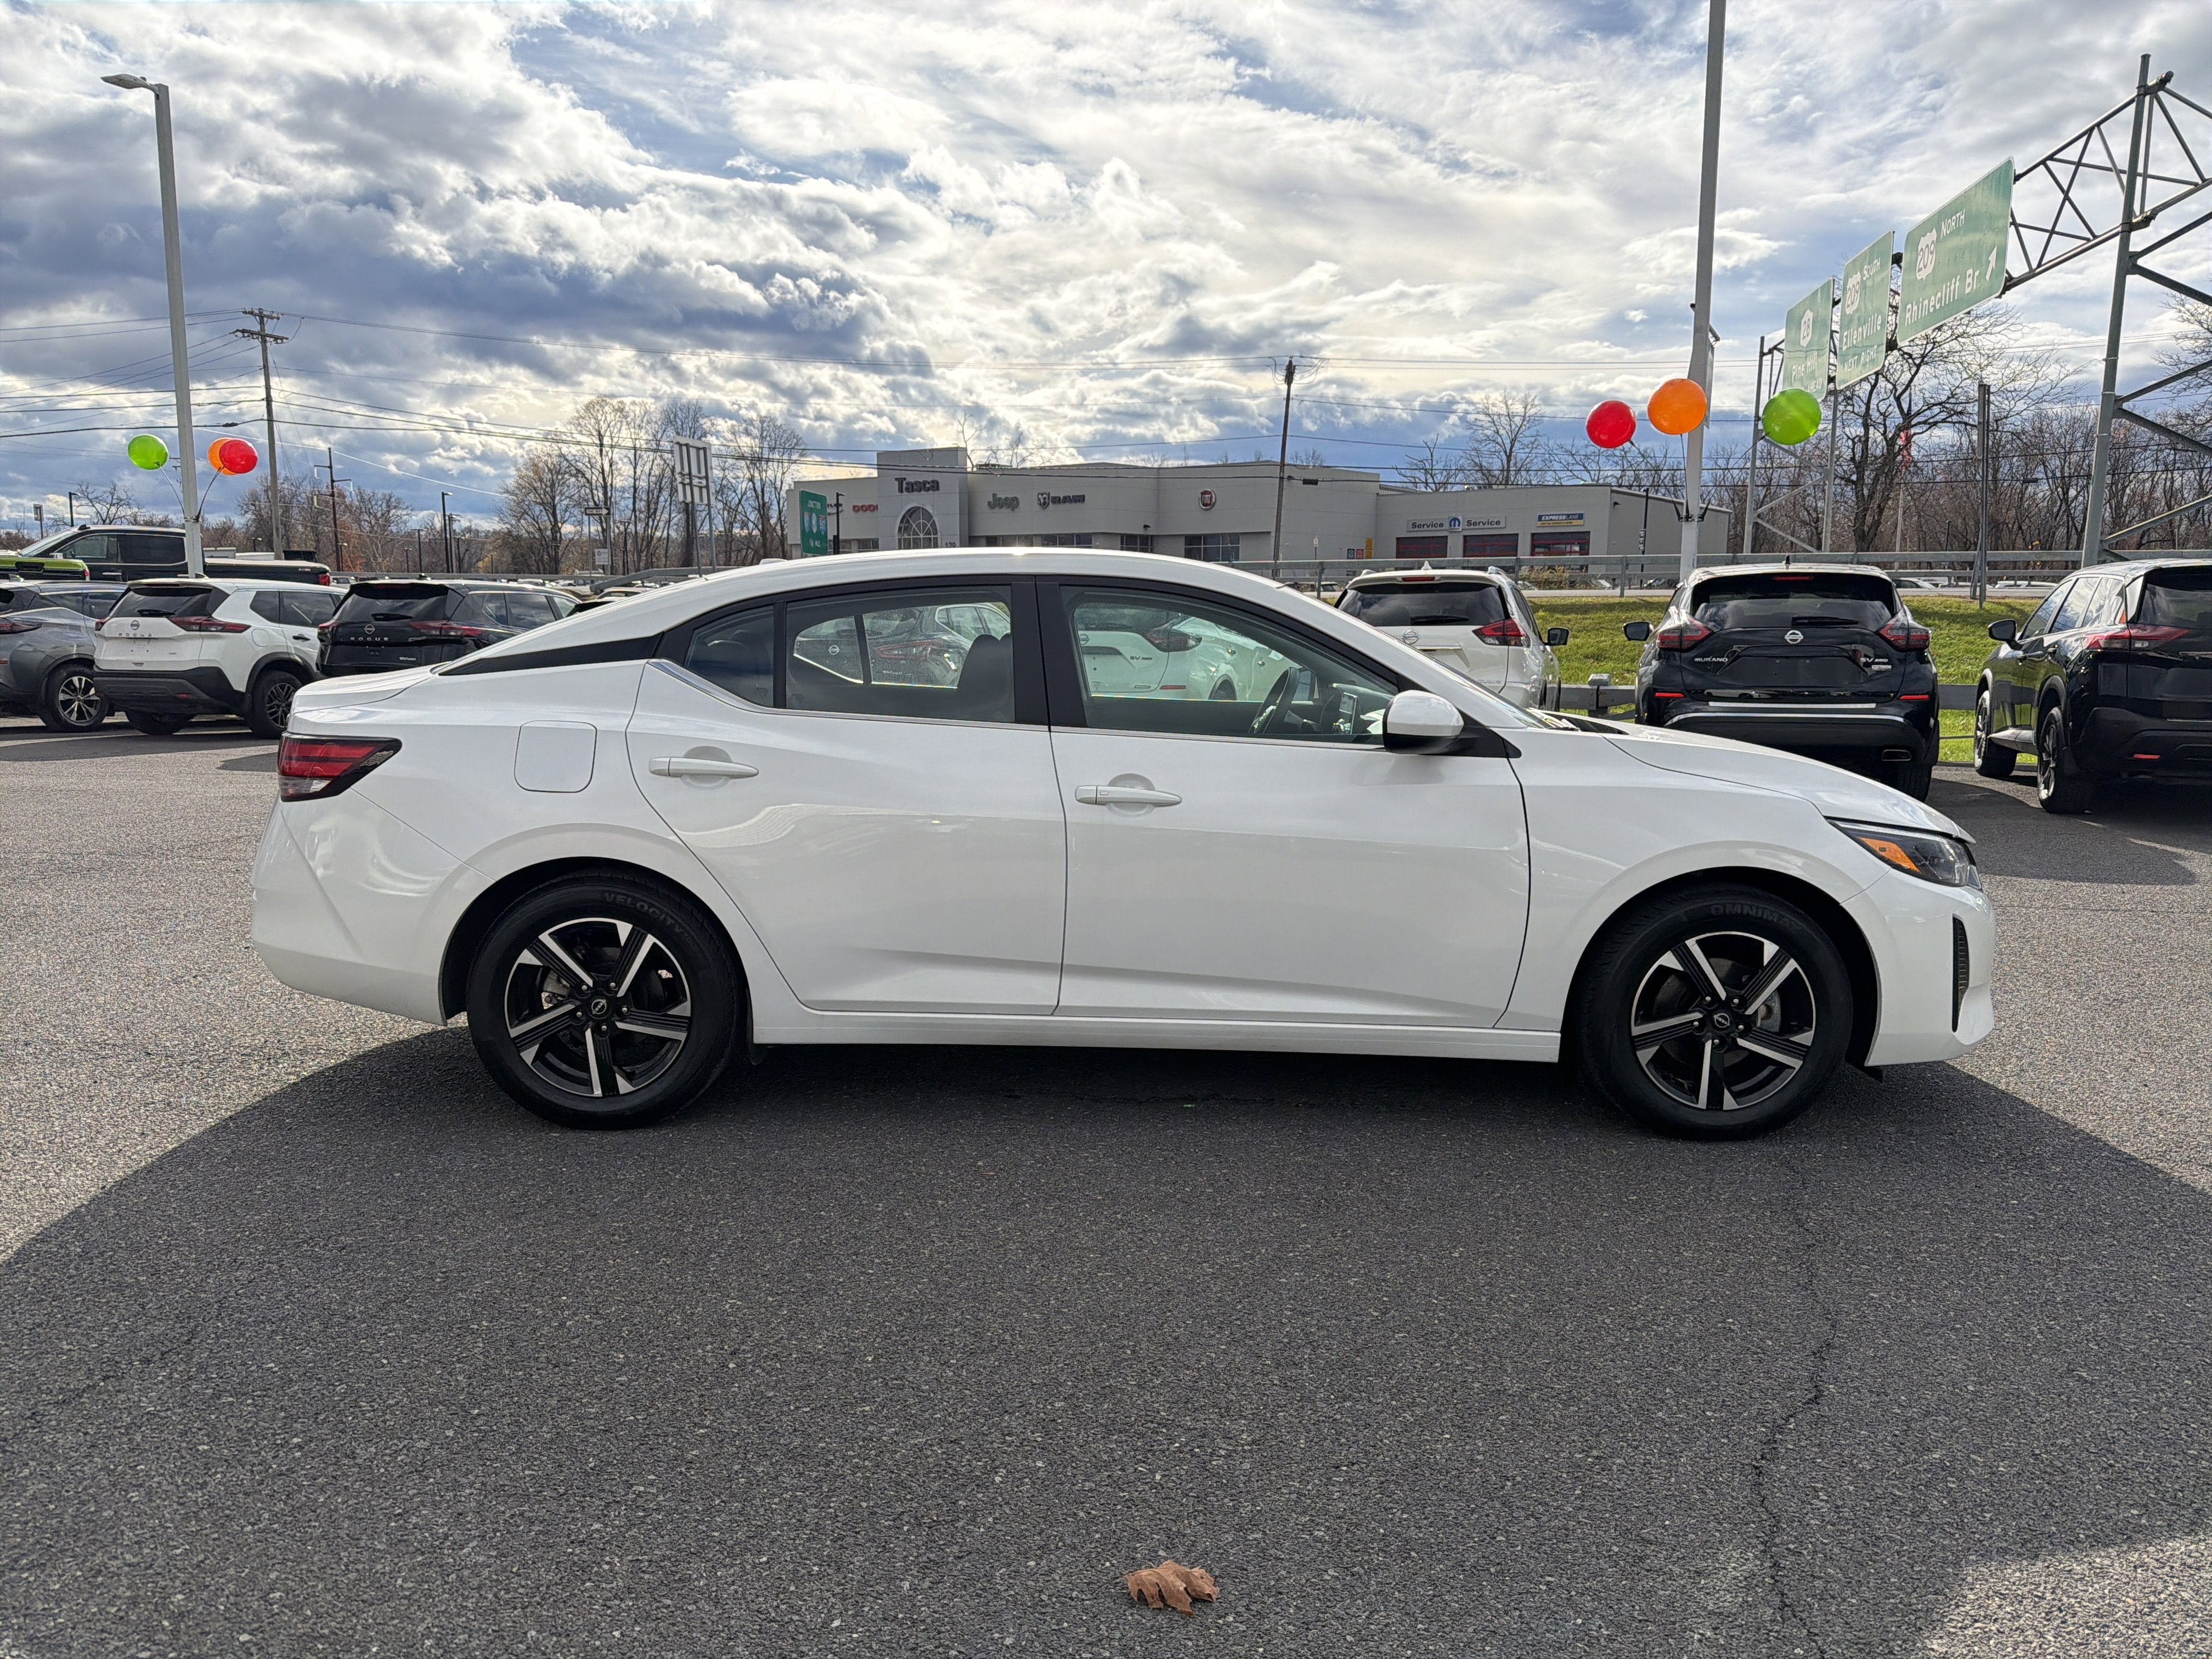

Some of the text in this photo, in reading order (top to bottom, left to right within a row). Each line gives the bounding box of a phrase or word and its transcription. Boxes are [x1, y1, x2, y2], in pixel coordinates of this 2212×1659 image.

[1940, 208, 1965, 239] NORTH
[1863, 257, 1881, 280] SOUTH
[1917, 240, 1935, 273] 209
[1847, 280, 1859, 309] 209
[1905, 268, 1979, 327] Rhinecliff Br
[1802, 318, 1810, 340] 28
[1842, 313, 1882, 351] Ellenville
[1791, 351, 1818, 382] Pine Hill
[1844, 345, 1878, 373] NEXT RIGHT
[1807, 377, 1822, 393] AHEAD
[894, 477, 940, 494] Tasca
[1051, 494, 1085, 504] RAM
[987, 493, 1020, 512] Jeep
[1466, 518, 1500, 527] Service
[605, 893, 685, 933] VELOCITY
